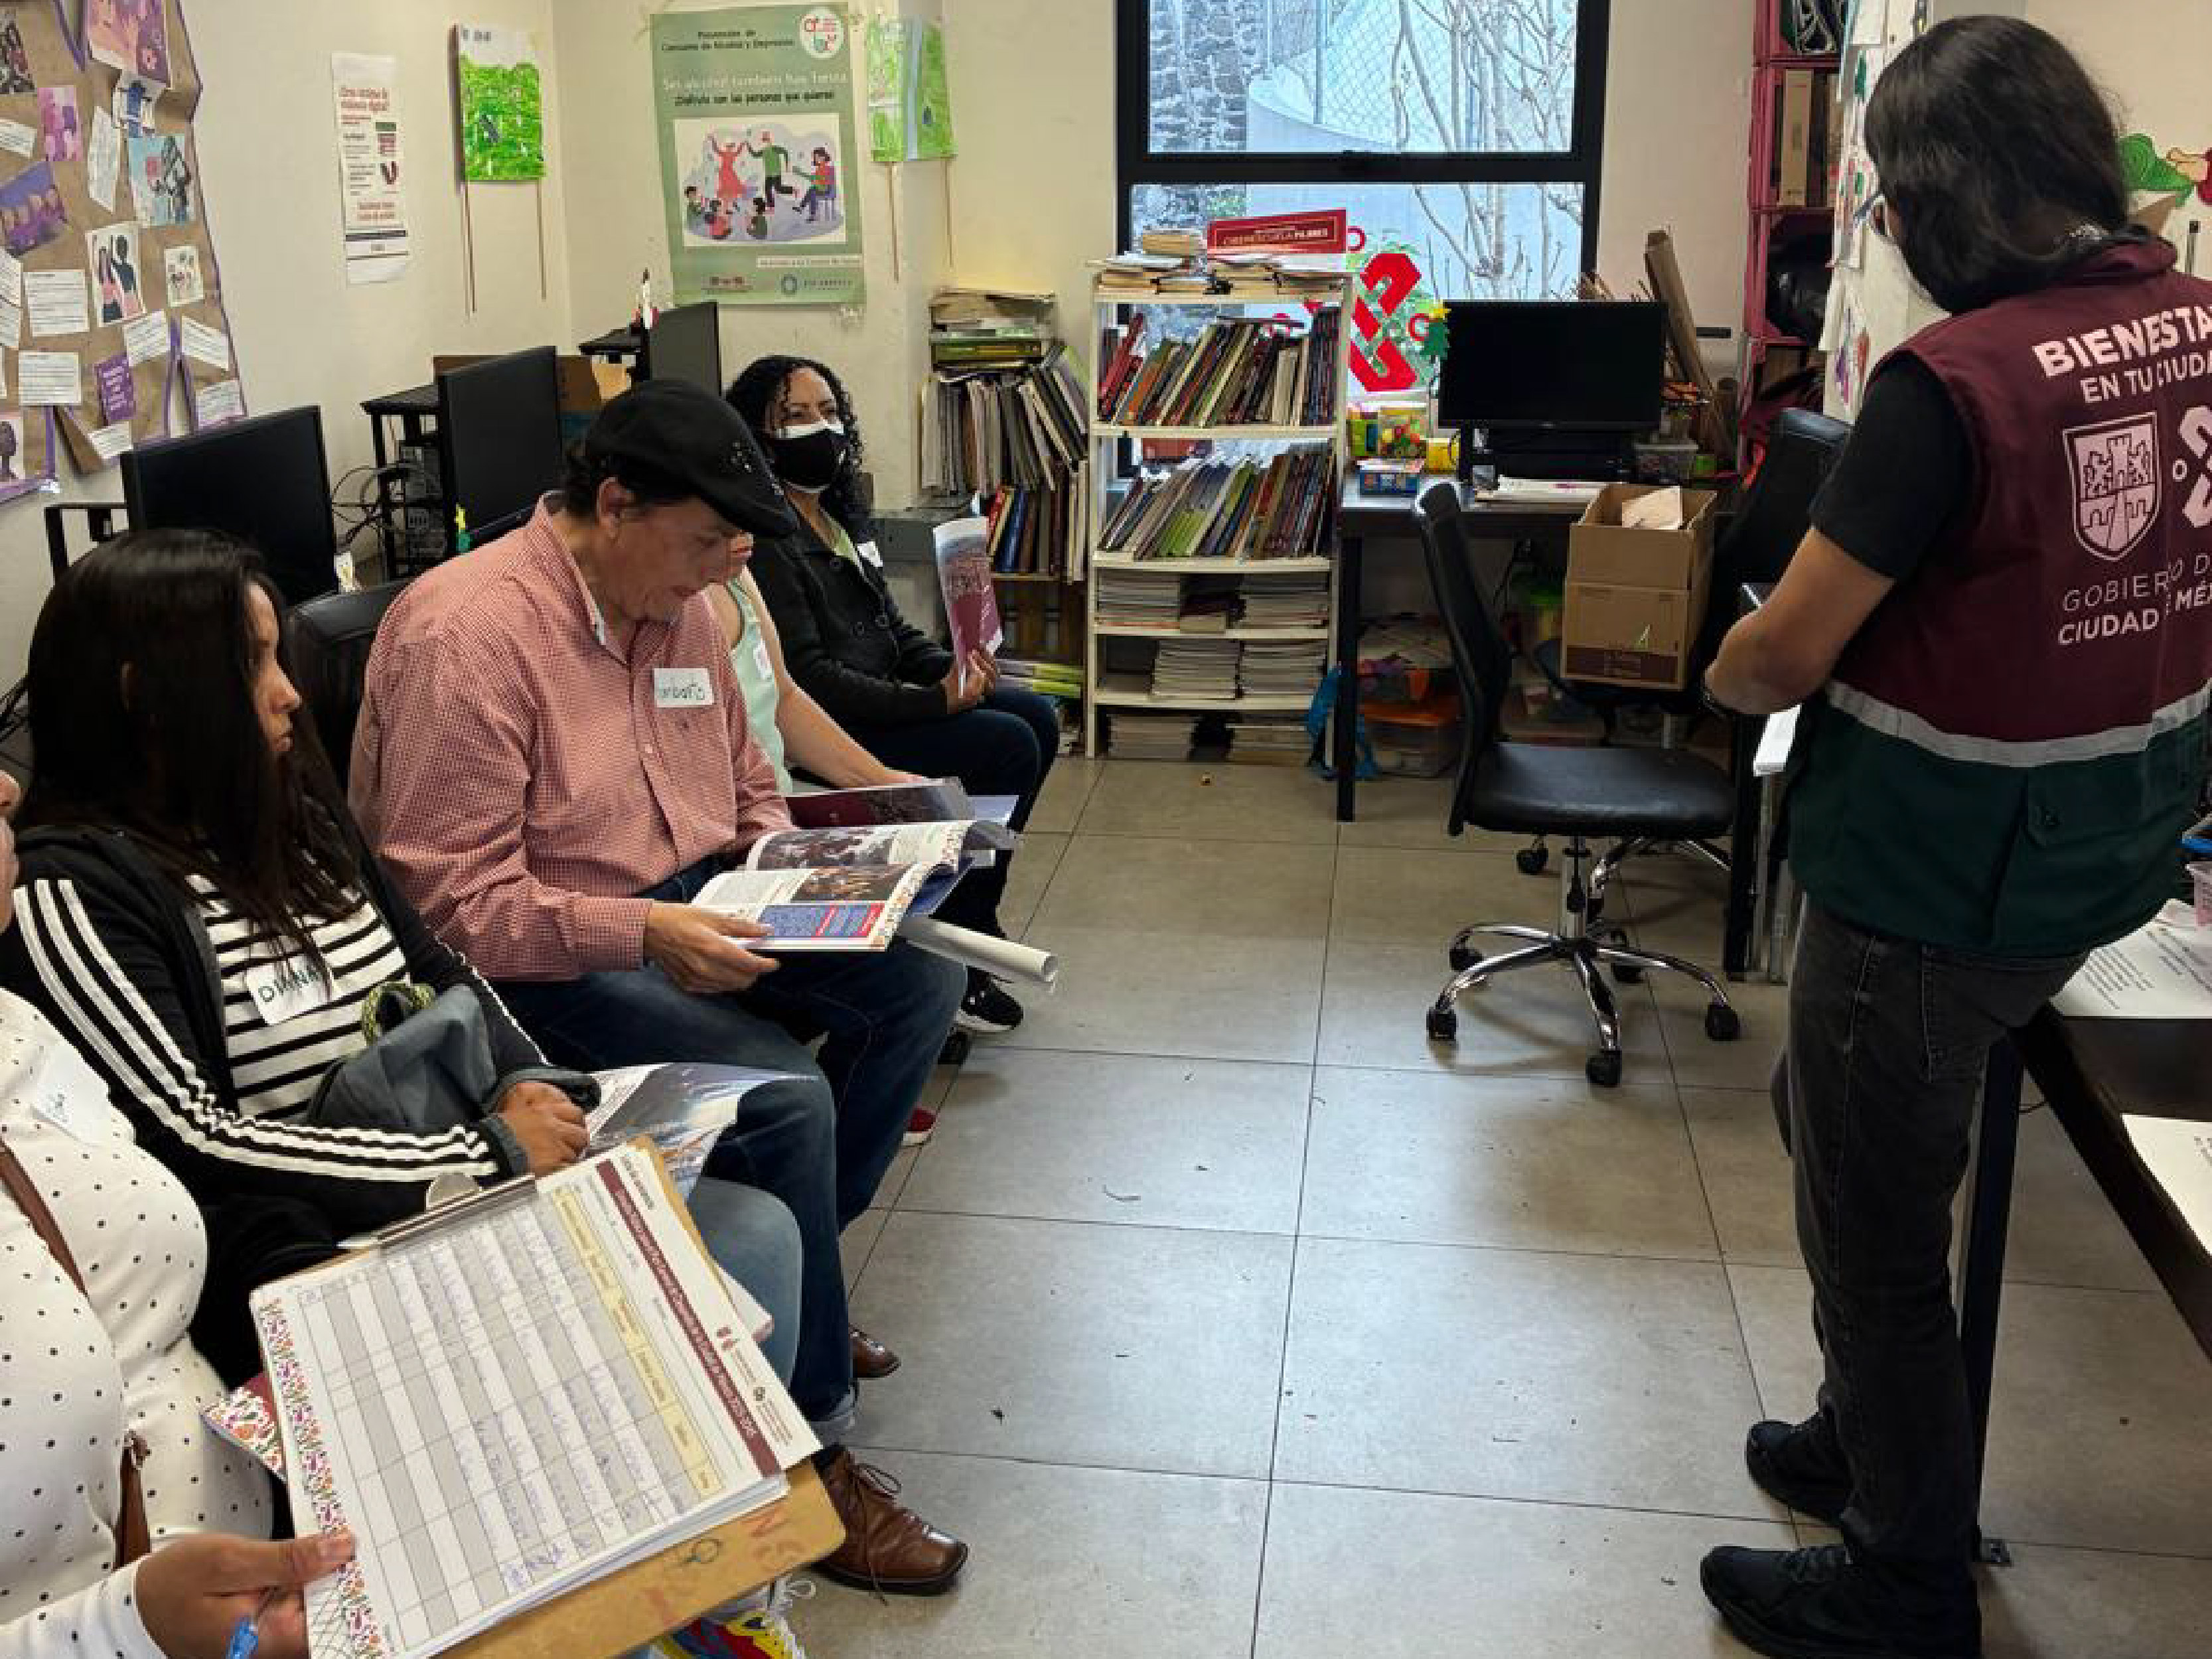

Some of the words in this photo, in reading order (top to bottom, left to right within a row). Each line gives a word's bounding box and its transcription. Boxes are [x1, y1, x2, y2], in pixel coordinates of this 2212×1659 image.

[2032, 305, 2212, 377] BIENESTA
[2080, 370, 2121, 404] EN
[2124, 365, 2153, 396] TU
[2063, 557, 2185, 613] GOBIERO
[2057, 608, 2160, 646] CIUDAD
